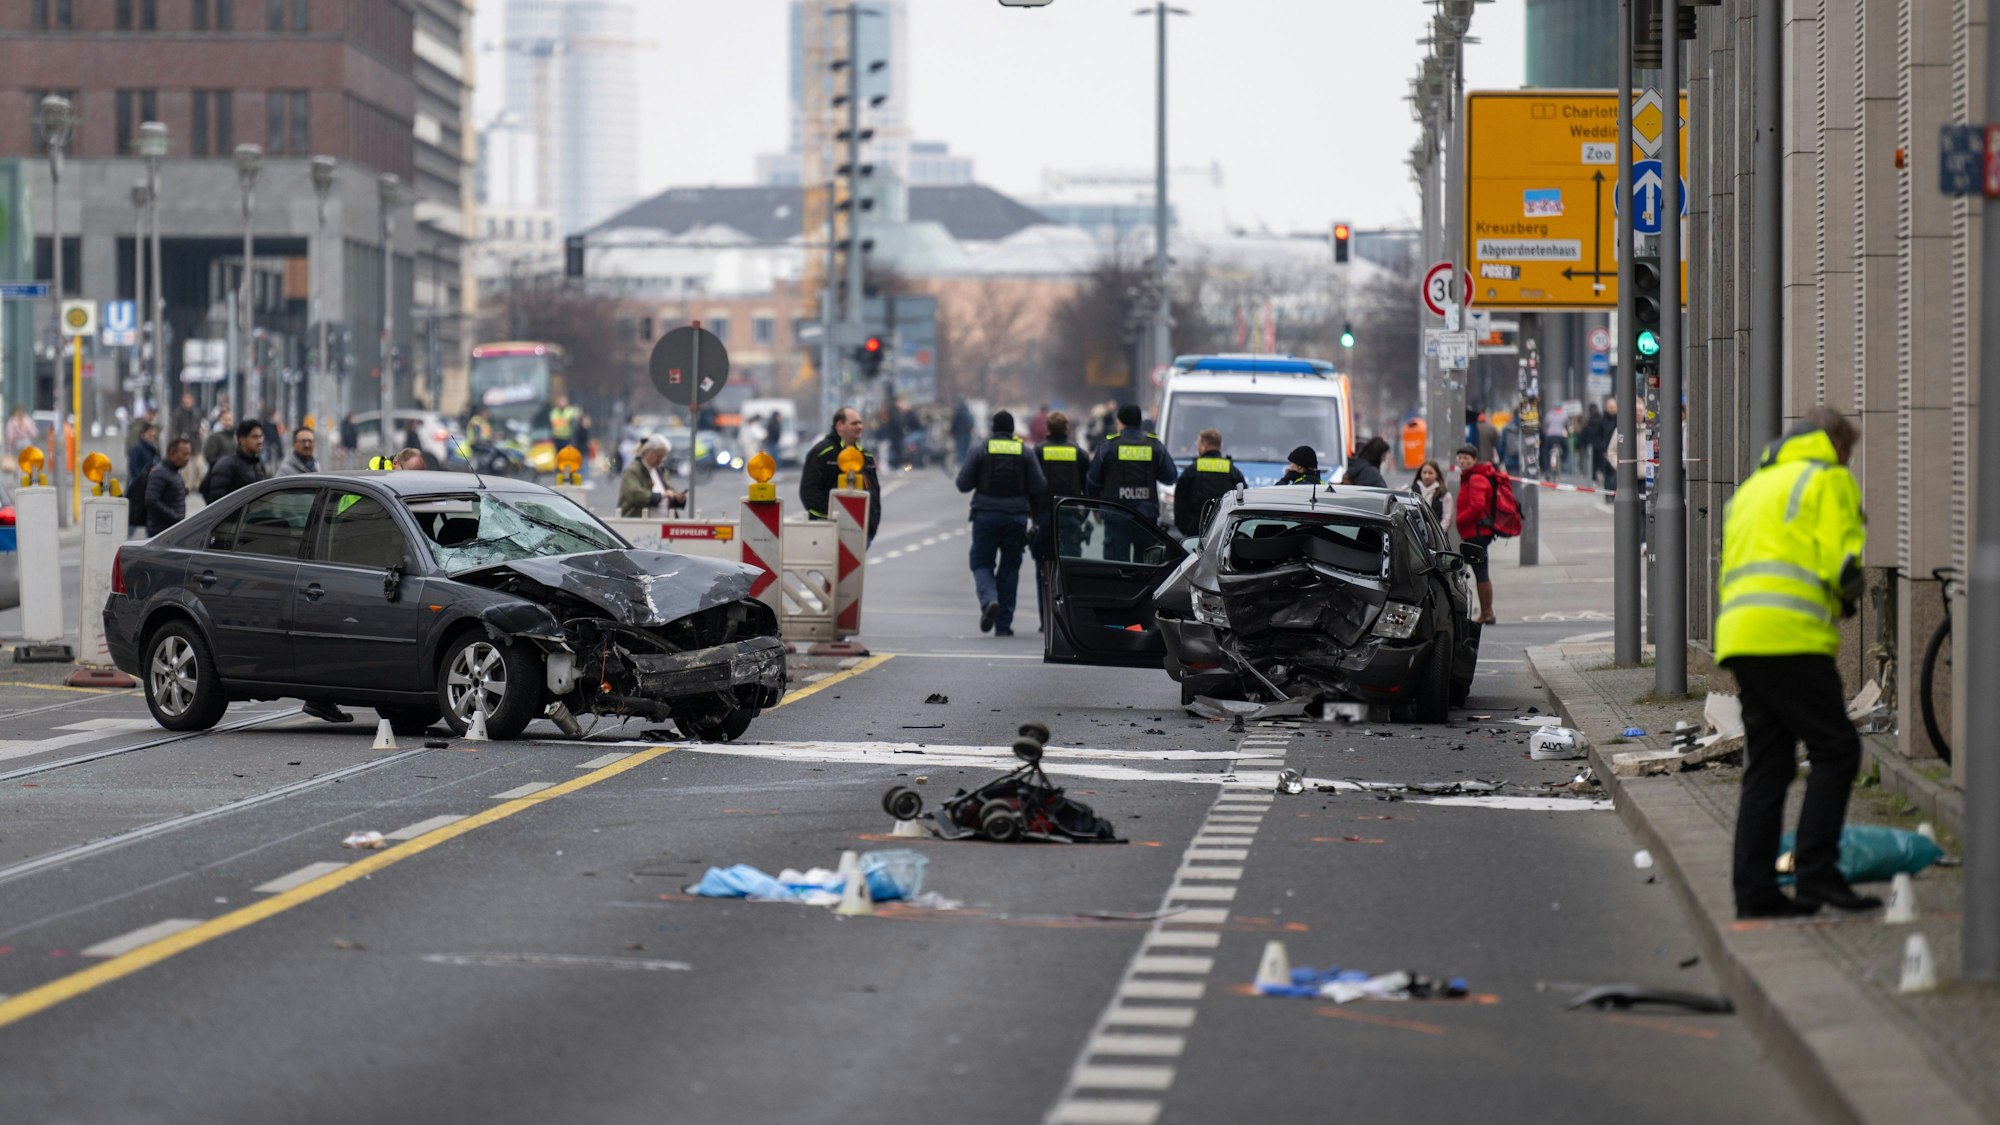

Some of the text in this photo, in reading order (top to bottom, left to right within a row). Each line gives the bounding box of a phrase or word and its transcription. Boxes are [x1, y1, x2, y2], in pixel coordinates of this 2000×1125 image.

[1563, 105, 1618, 118] Charlott
[1587, 147, 1611, 160] Zoo
[1476, 222, 1548, 237] Kreuzberg
[1481, 244, 1576, 259] Abgeordnetenhaus
[108, 302, 131, 331] U
[1119, 487, 1150, 499] POLIZEI
[669, 528, 708, 536] ZEPPELIN
